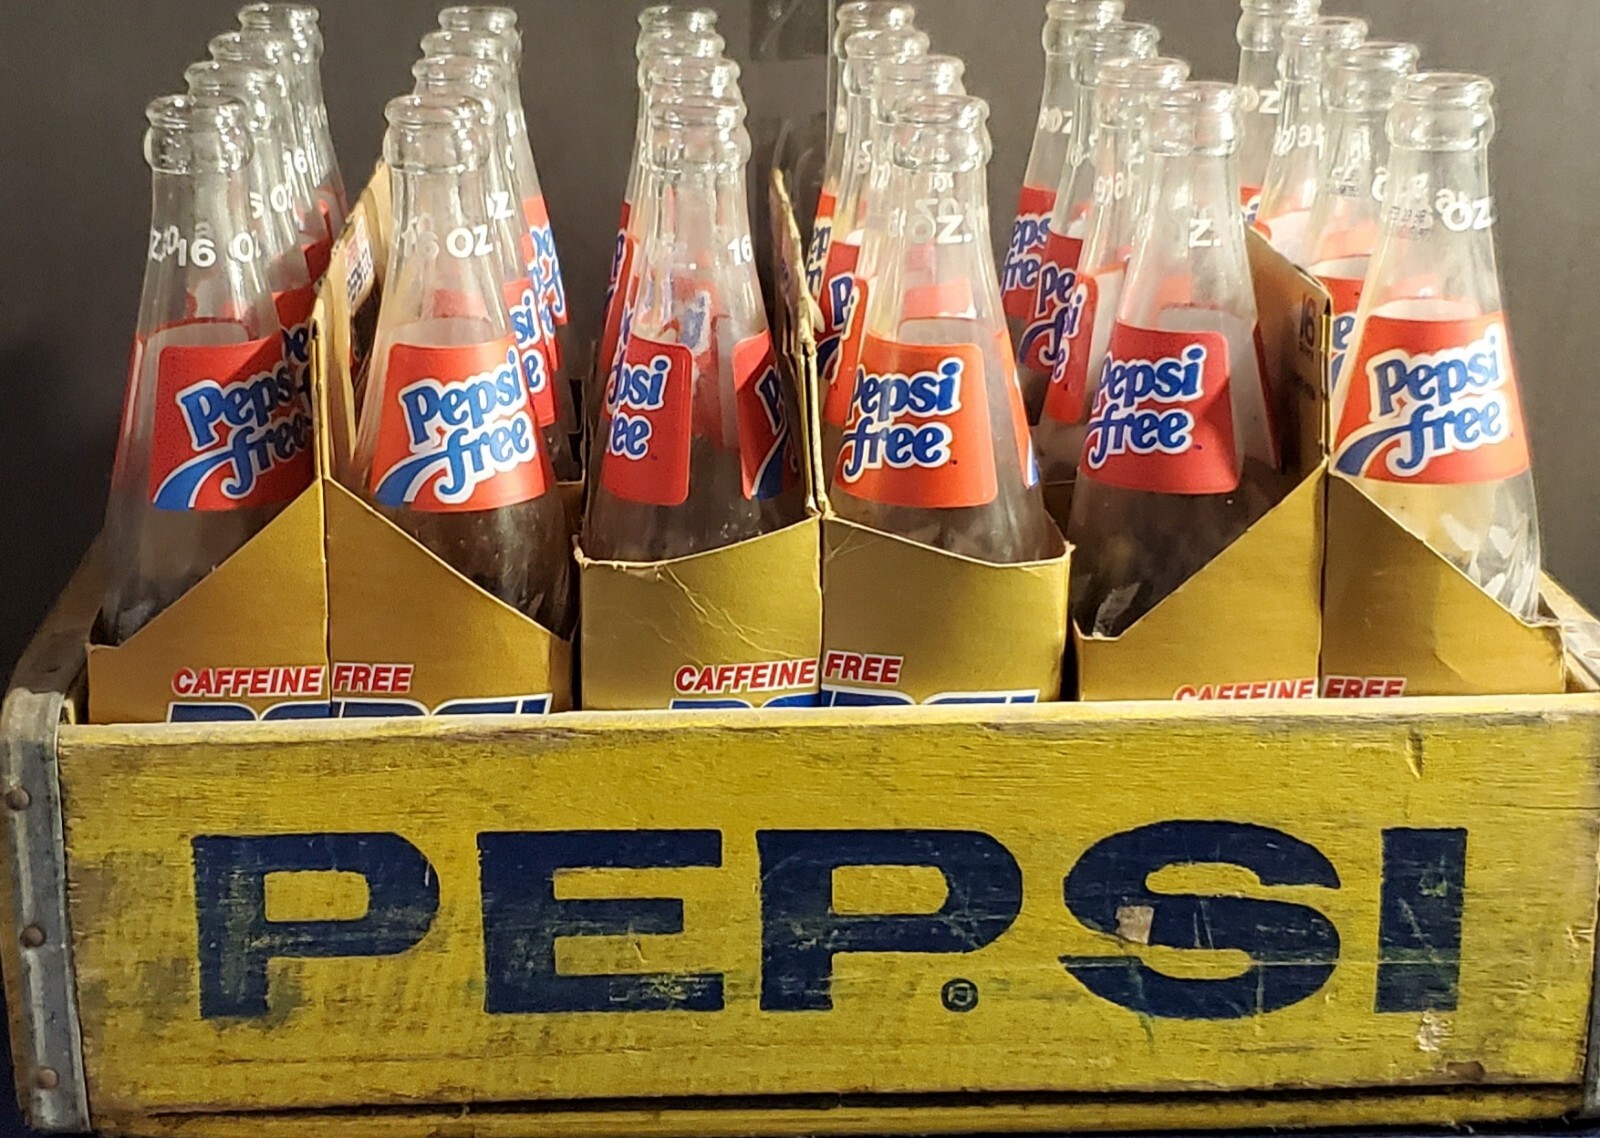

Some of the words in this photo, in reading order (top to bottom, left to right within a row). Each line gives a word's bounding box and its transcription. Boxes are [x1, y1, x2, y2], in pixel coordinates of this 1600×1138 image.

[178, 238, 216, 267] 16
[446, 224, 494, 258] OZ
[400, 344, 523, 446] Pepsi
[1373, 334, 1500, 417] Pepsi
[178, 366, 297, 449] Peps
[1086, 402, 1189, 465] free
[1395, 400, 1503, 470] free
[436, 416, 531, 497] free
[842, 415, 946, 478] free
[171, 665, 326, 697] CAFFEINE
[331, 662, 415, 693] FREE
[672, 658, 819, 693] CAFFEINE
[824, 650, 904, 685] FREE
[1323, 677, 1406, 699] FREE
[191, 820, 1467, 1019] PEPSI
